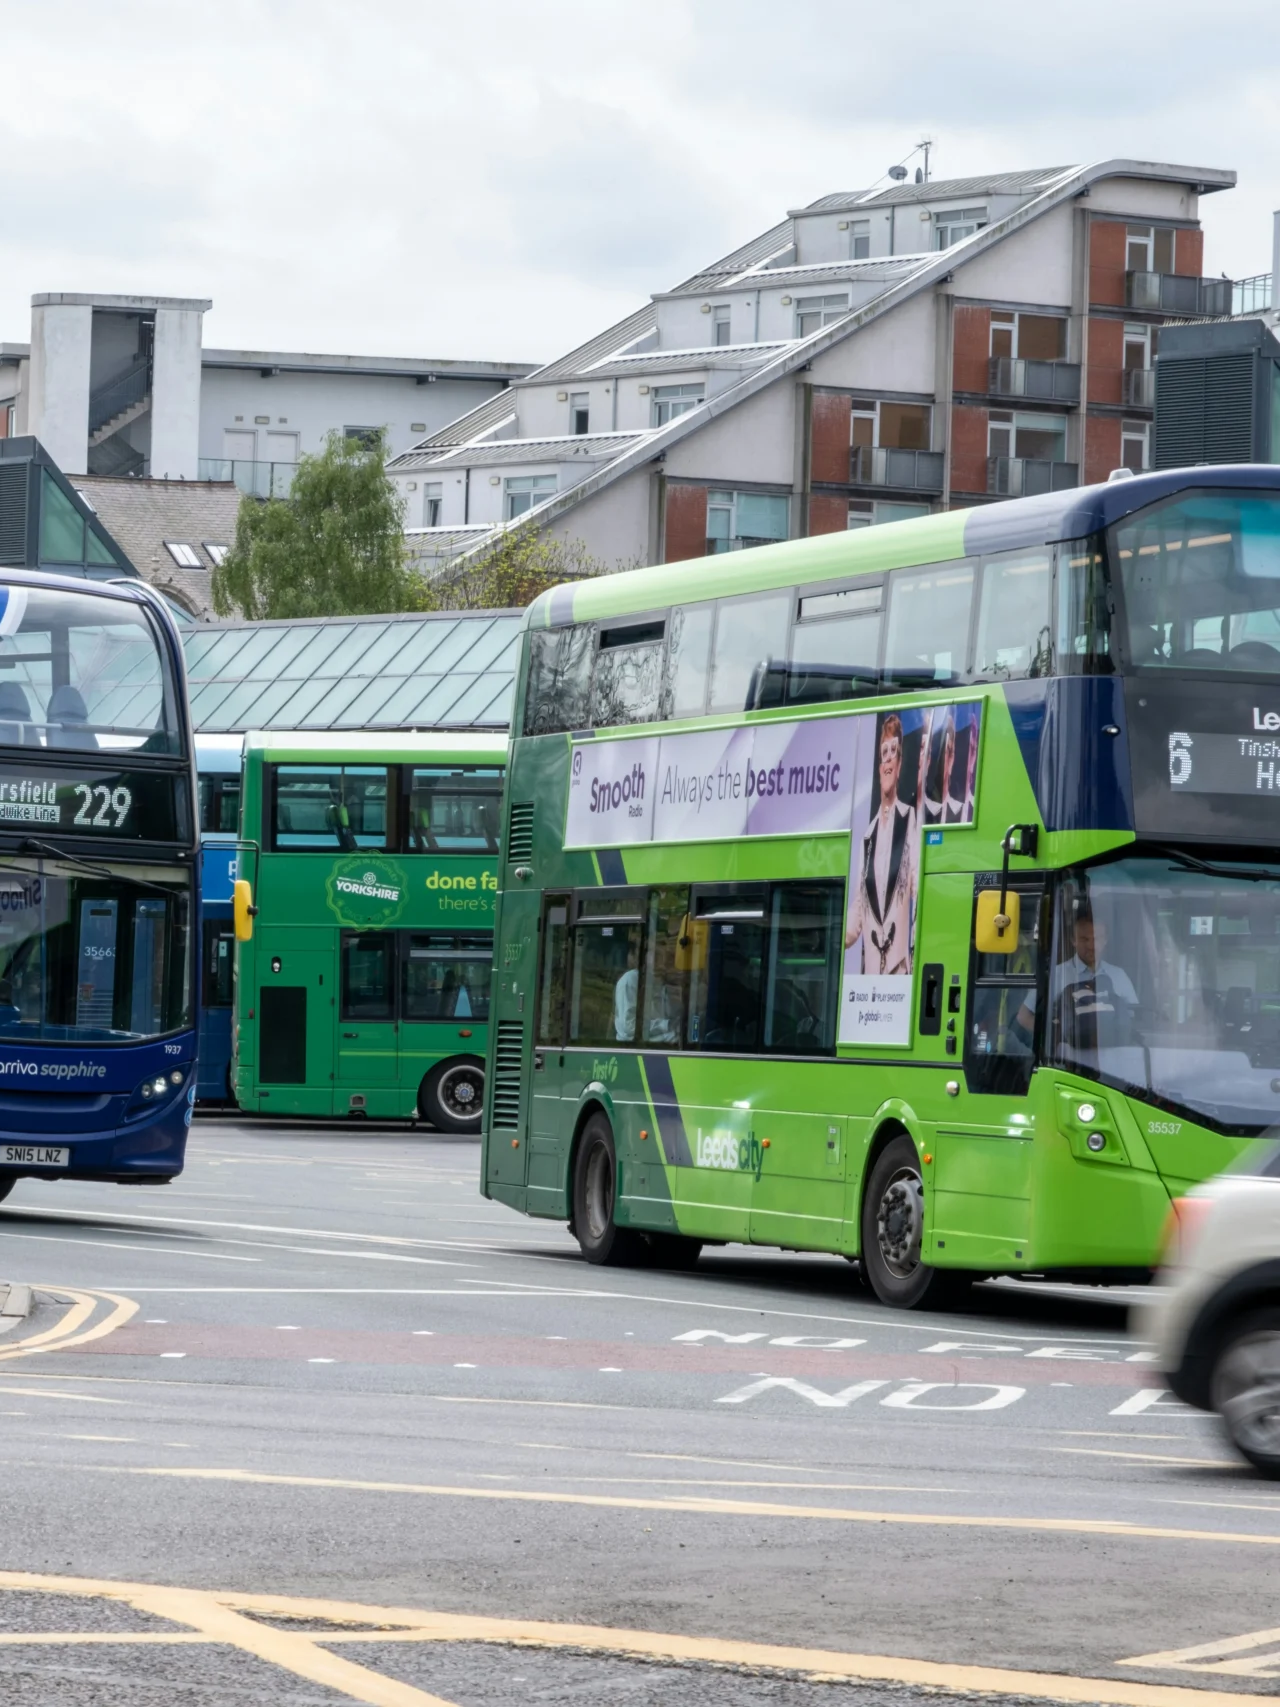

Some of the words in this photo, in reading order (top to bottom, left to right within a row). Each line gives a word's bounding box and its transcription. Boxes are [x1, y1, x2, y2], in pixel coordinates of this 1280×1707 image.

[1168, 732, 1193, 784] 6
[590, 763, 645, 813] Smooth
[661, 764, 713, 813] Always
[717, 759, 741, 799] the
[745, 758, 784, 797] best
[788, 752, 840, 795] music
[34, 806, 57, 822] Line
[74, 784, 132, 827] 229
[628, 804, 643, 818] Radio
[425, 871, 477, 890] done
[336, 880, 400, 901] YORKSHIRE
[164, 1044, 181, 1055] 1937
[40, 1061, 107, 1080] sapphire
[593, 1059, 608, 1081] First
[1148, 1121, 1182, 1135] 35537
[6, 1147, 34, 1162] SN15
[36, 1149, 62, 1163] LNZ
[671, 1329, 868, 1348] NO
[712, 1376, 1027, 1411] NO
